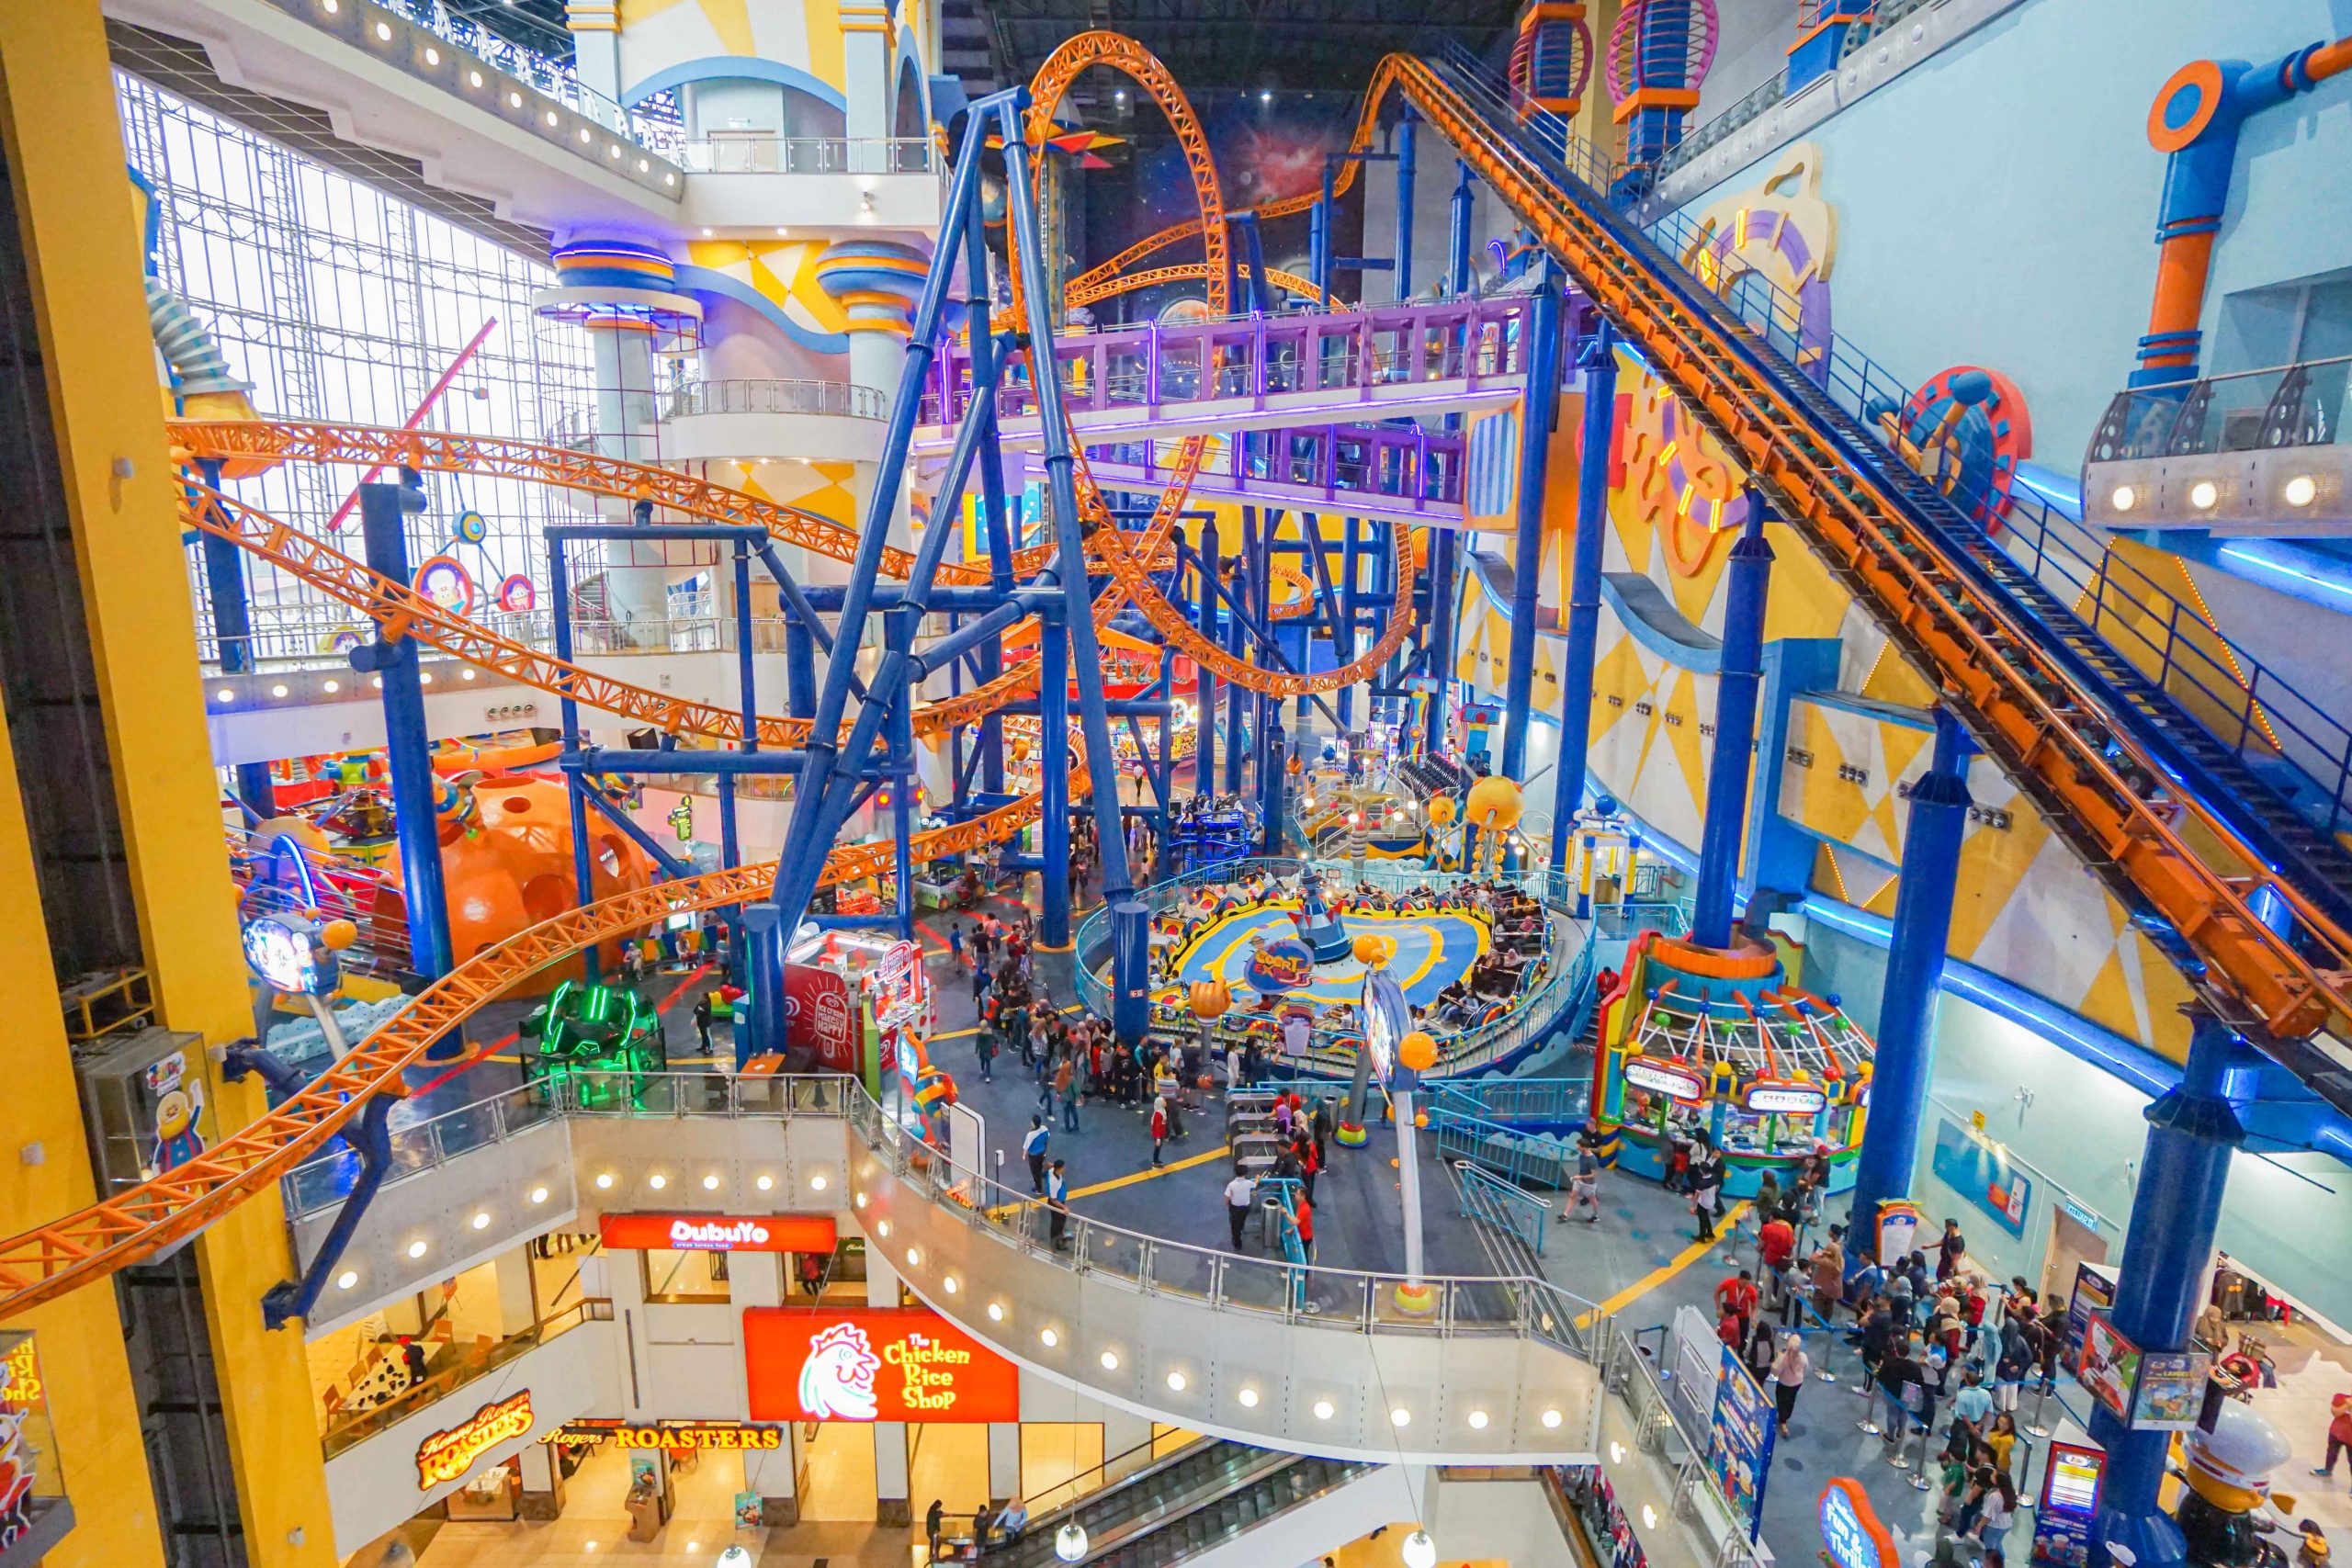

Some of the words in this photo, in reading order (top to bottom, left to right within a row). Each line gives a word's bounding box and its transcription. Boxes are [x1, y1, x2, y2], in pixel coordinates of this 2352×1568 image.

[670, 1220, 769, 1243] DubuYo
[884, 1338, 970, 1365] Chicken
[908, 1333, 930, 1347] The
[902, 1363, 954, 1387] Rice
[901, 1385, 956, 1410] Shop
[419, 1422, 476, 1461] Kenny
[476, 1392, 531, 1427] Rogers
[537, 1427, 604, 1449] Rogers
[615, 1428, 780, 1450] ROASTERS
[419, 1402, 535, 1490] ROASTERS
[1826, 1502, 1849, 1541] Fun
[1850, 1531, 1863, 1554] &
[1829, 1530, 1871, 1568] Thrill
